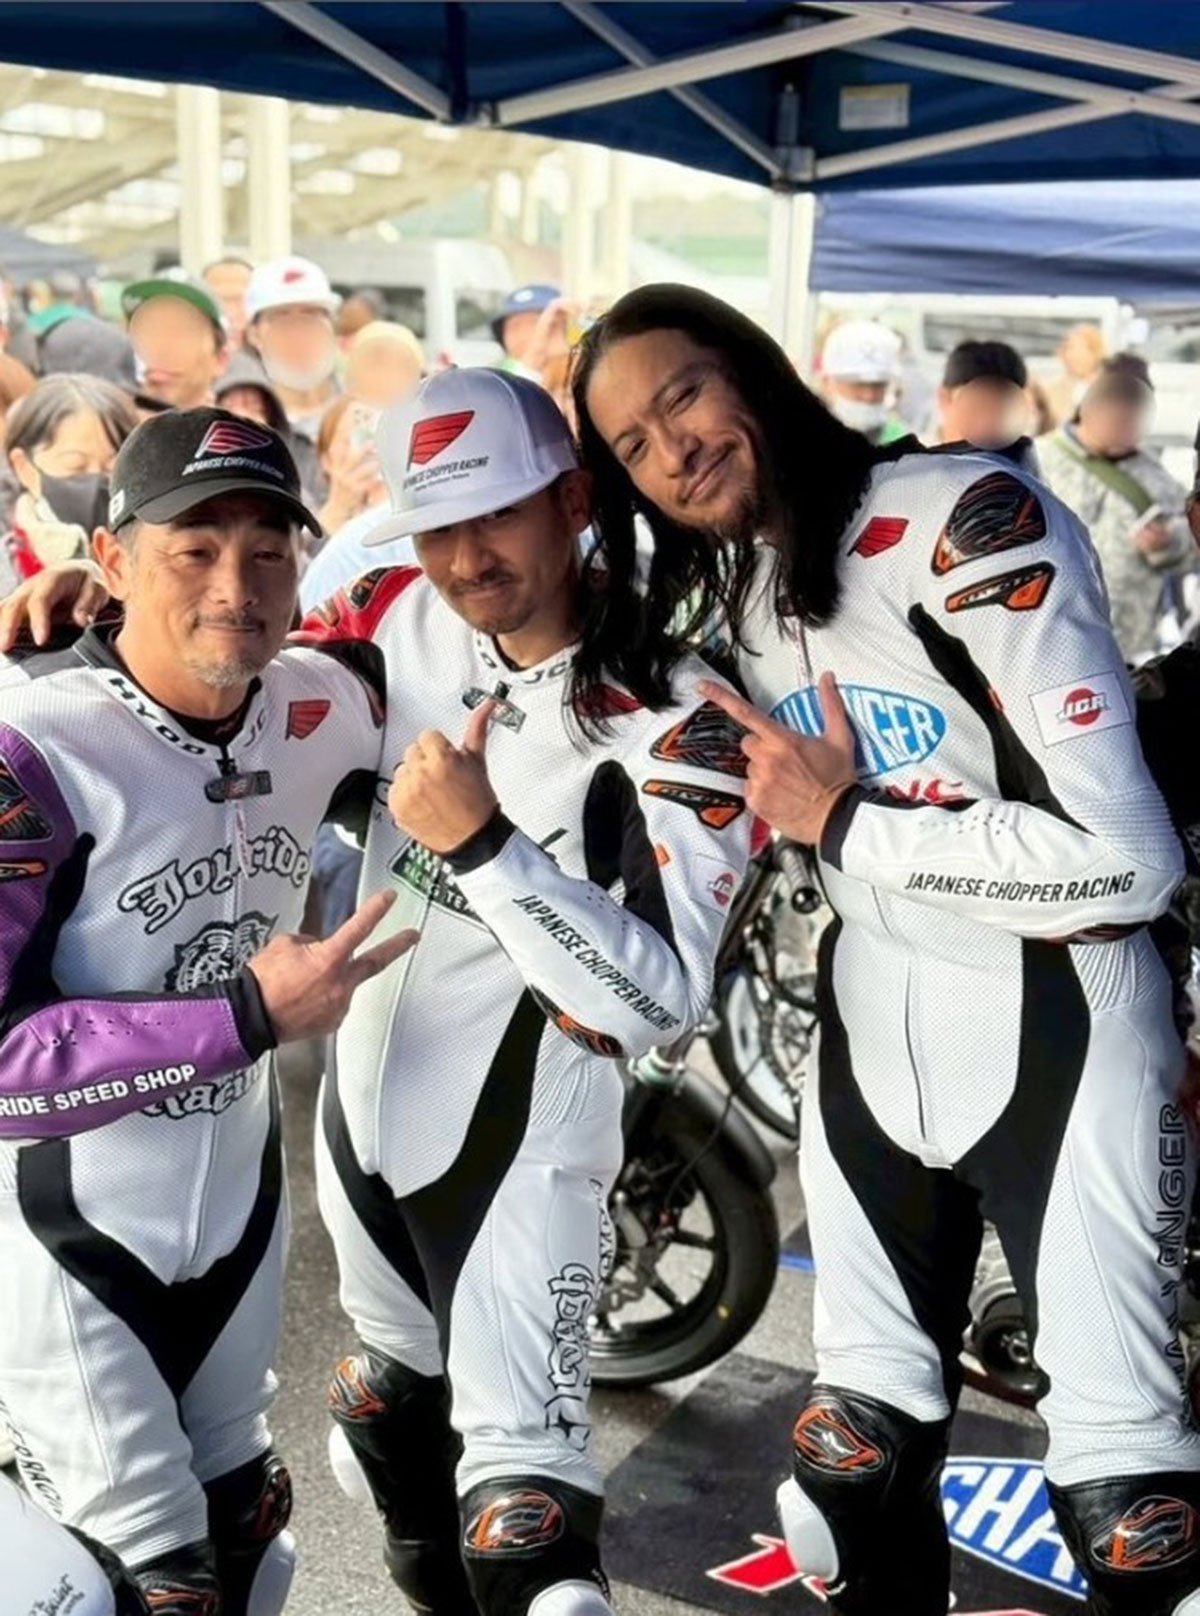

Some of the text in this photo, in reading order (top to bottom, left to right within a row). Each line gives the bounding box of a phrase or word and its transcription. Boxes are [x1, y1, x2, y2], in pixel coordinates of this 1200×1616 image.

[904, 870, 1137, 903] JAPANESE CHOPPER RACING
[512, 894, 680, 1031] JAPANESE CHOPPER RACING
[53, 1080, 129, 1111] SPEED
[133, 1063, 196, 1094] SHOP
